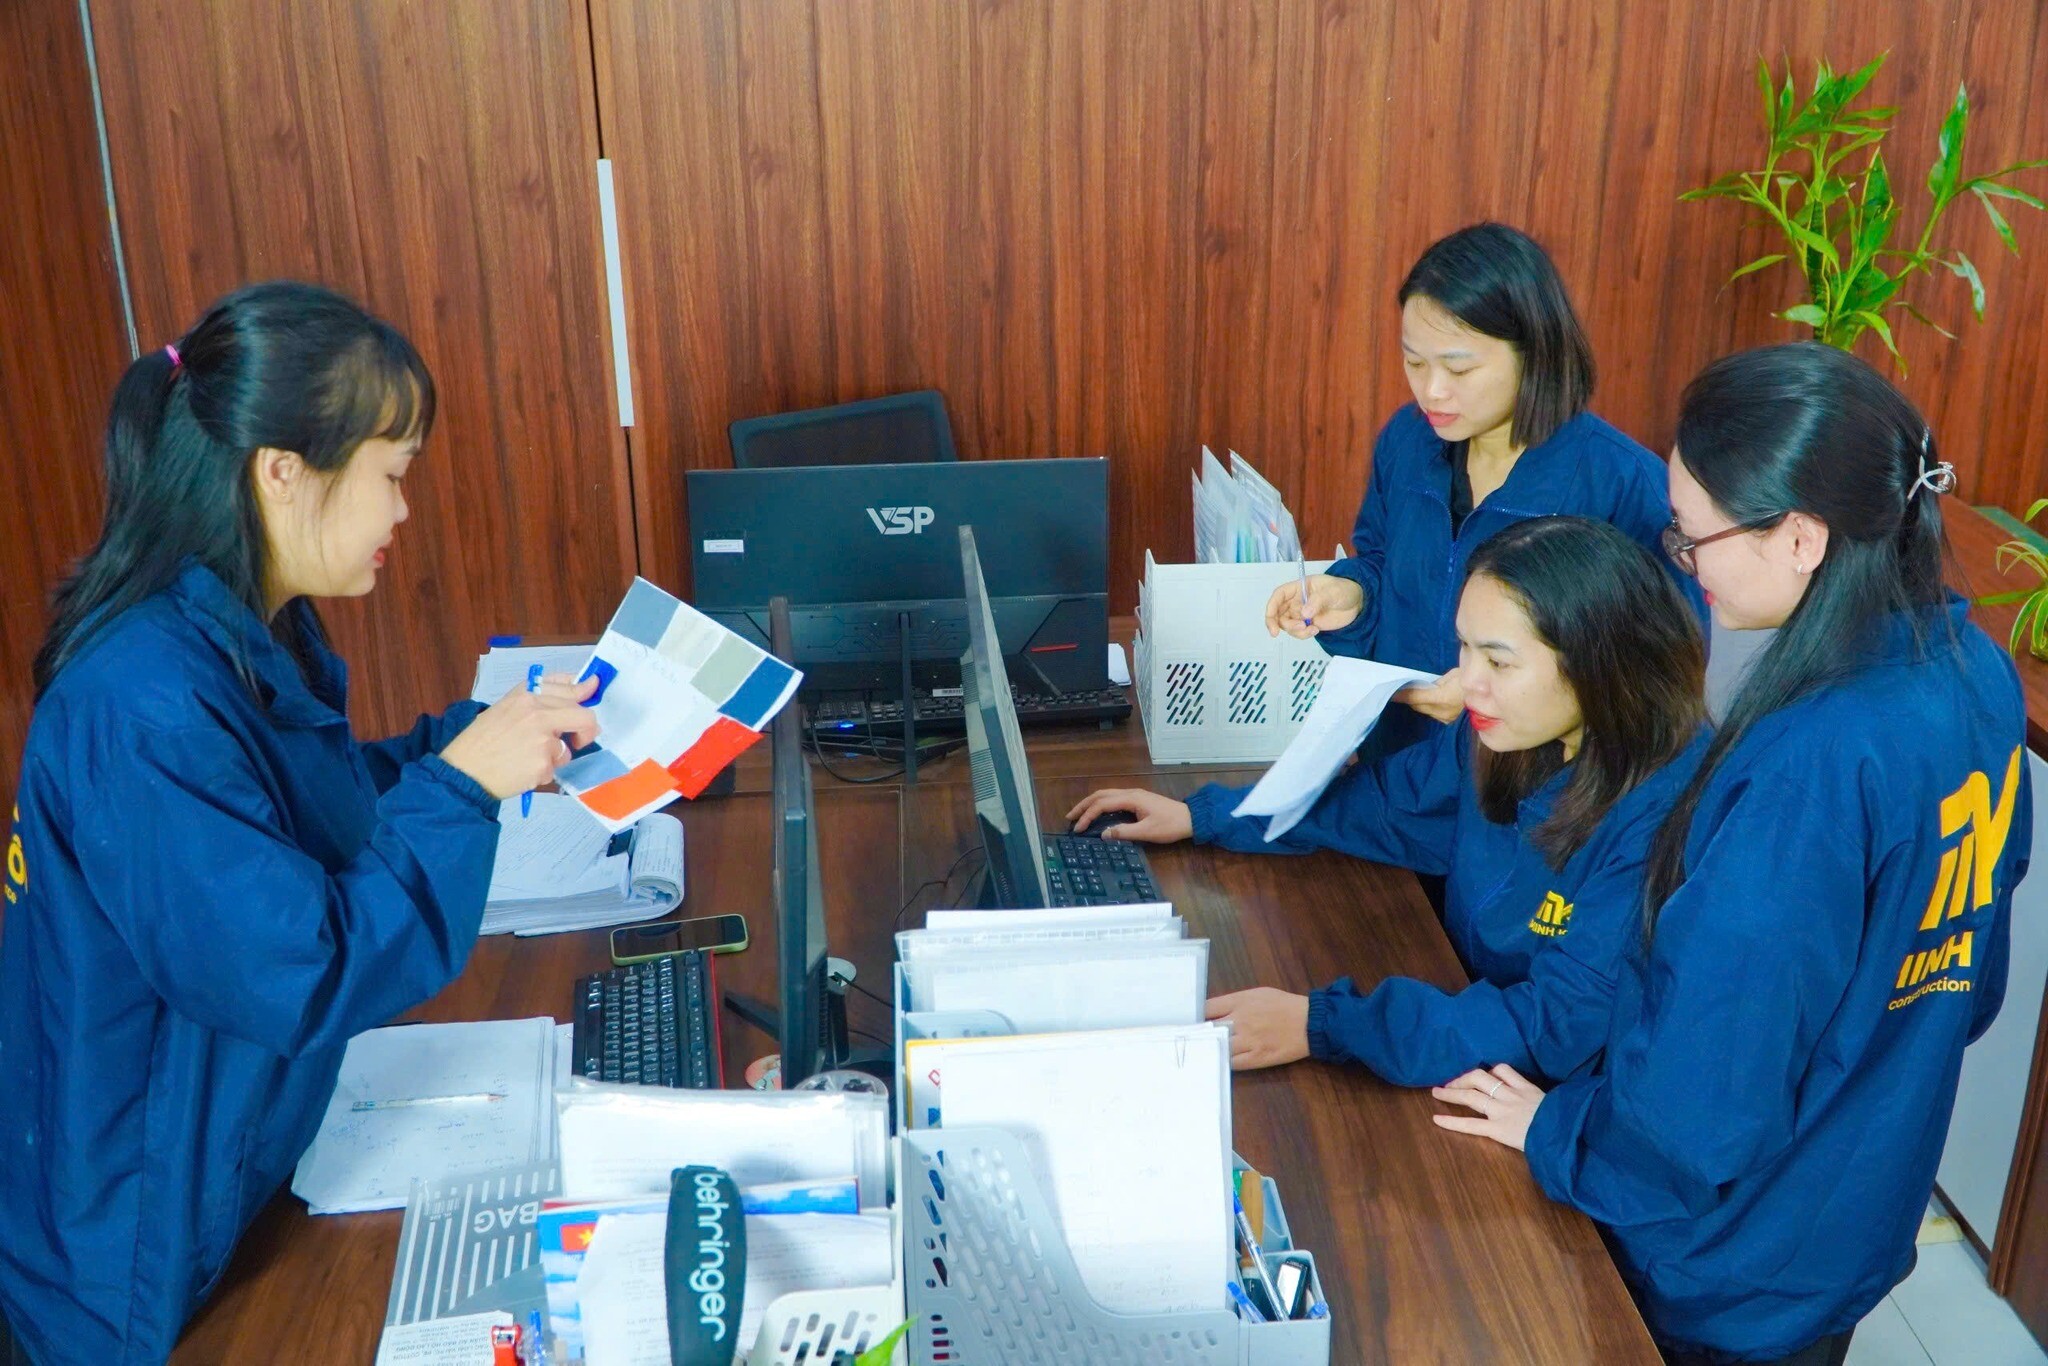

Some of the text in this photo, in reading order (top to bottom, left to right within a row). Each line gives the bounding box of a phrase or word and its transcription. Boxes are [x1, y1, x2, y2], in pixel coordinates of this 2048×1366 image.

[866, 506, 935, 535] VSP
[1888, 977, 1971, 1011] construction
[473, 1201, 539, 1234] BAG
[689, 1172, 731, 1342] behringer
